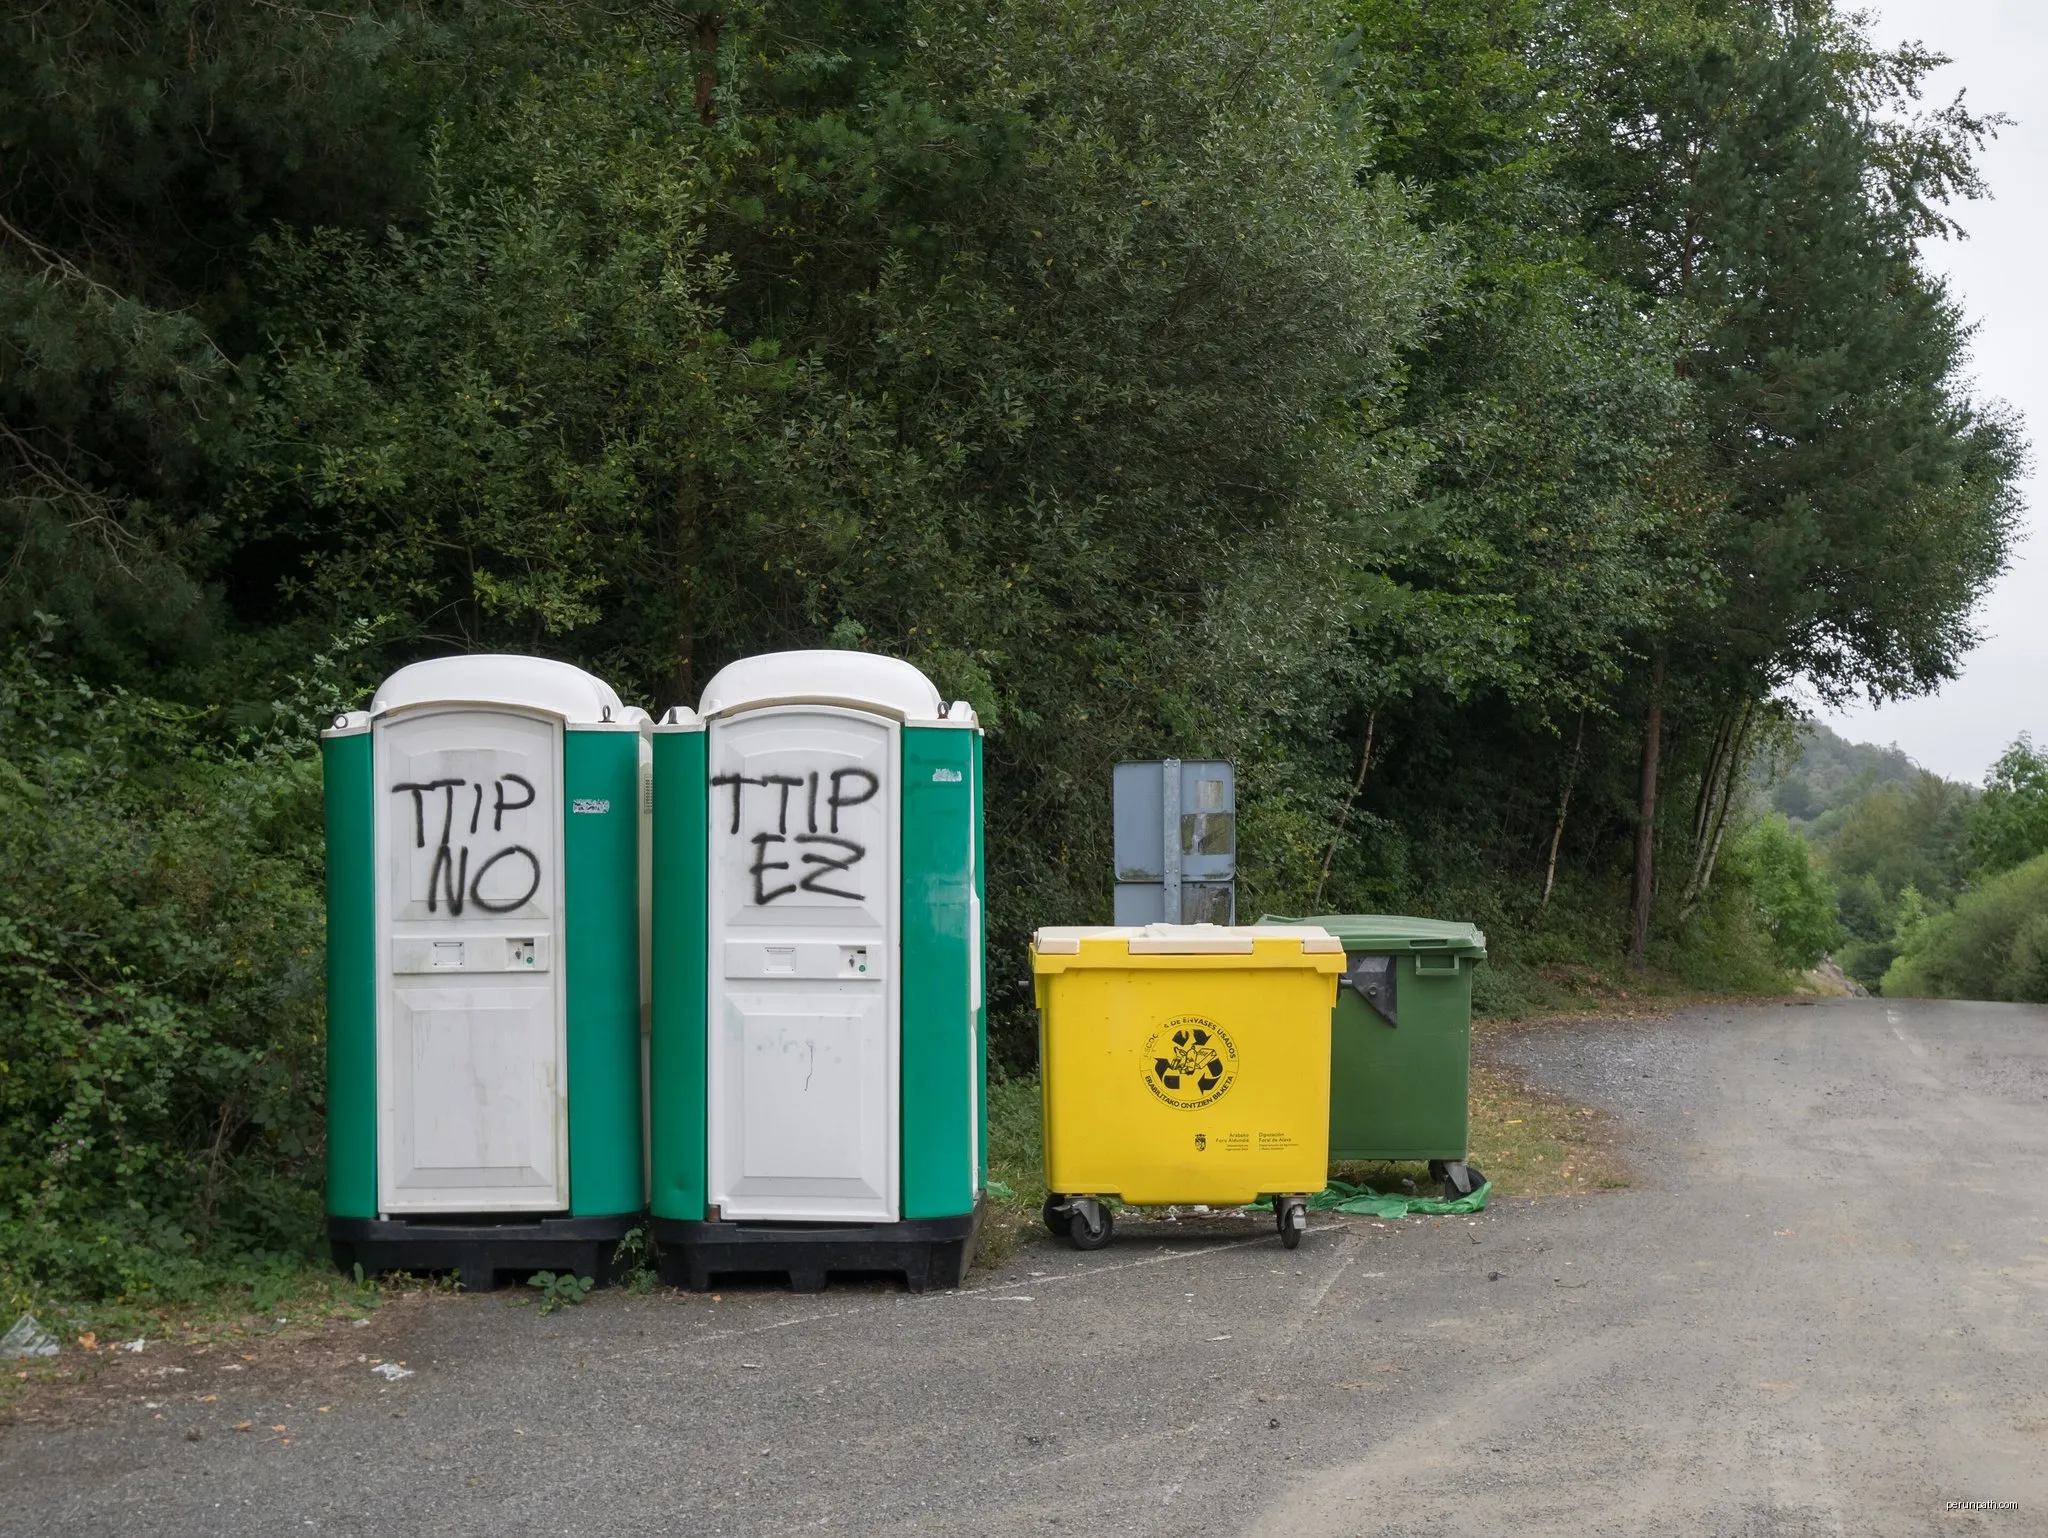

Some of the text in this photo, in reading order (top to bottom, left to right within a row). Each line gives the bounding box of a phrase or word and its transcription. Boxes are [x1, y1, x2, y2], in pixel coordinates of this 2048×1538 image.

[391, 773, 536, 848] TTIP
[710, 766, 880, 835] TTIP
[427, 844, 541, 917] NO
[749, 832, 866, 905] EZ
[1170, 1019, 1181, 1027] DE
[1182, 1017, 1217, 1031] ENVASES
[1216, 1028, 1237, 1059] USADOS
[1145, 1075, 1234, 1109] ERABILITAKO ONTZIEN BILKETA
